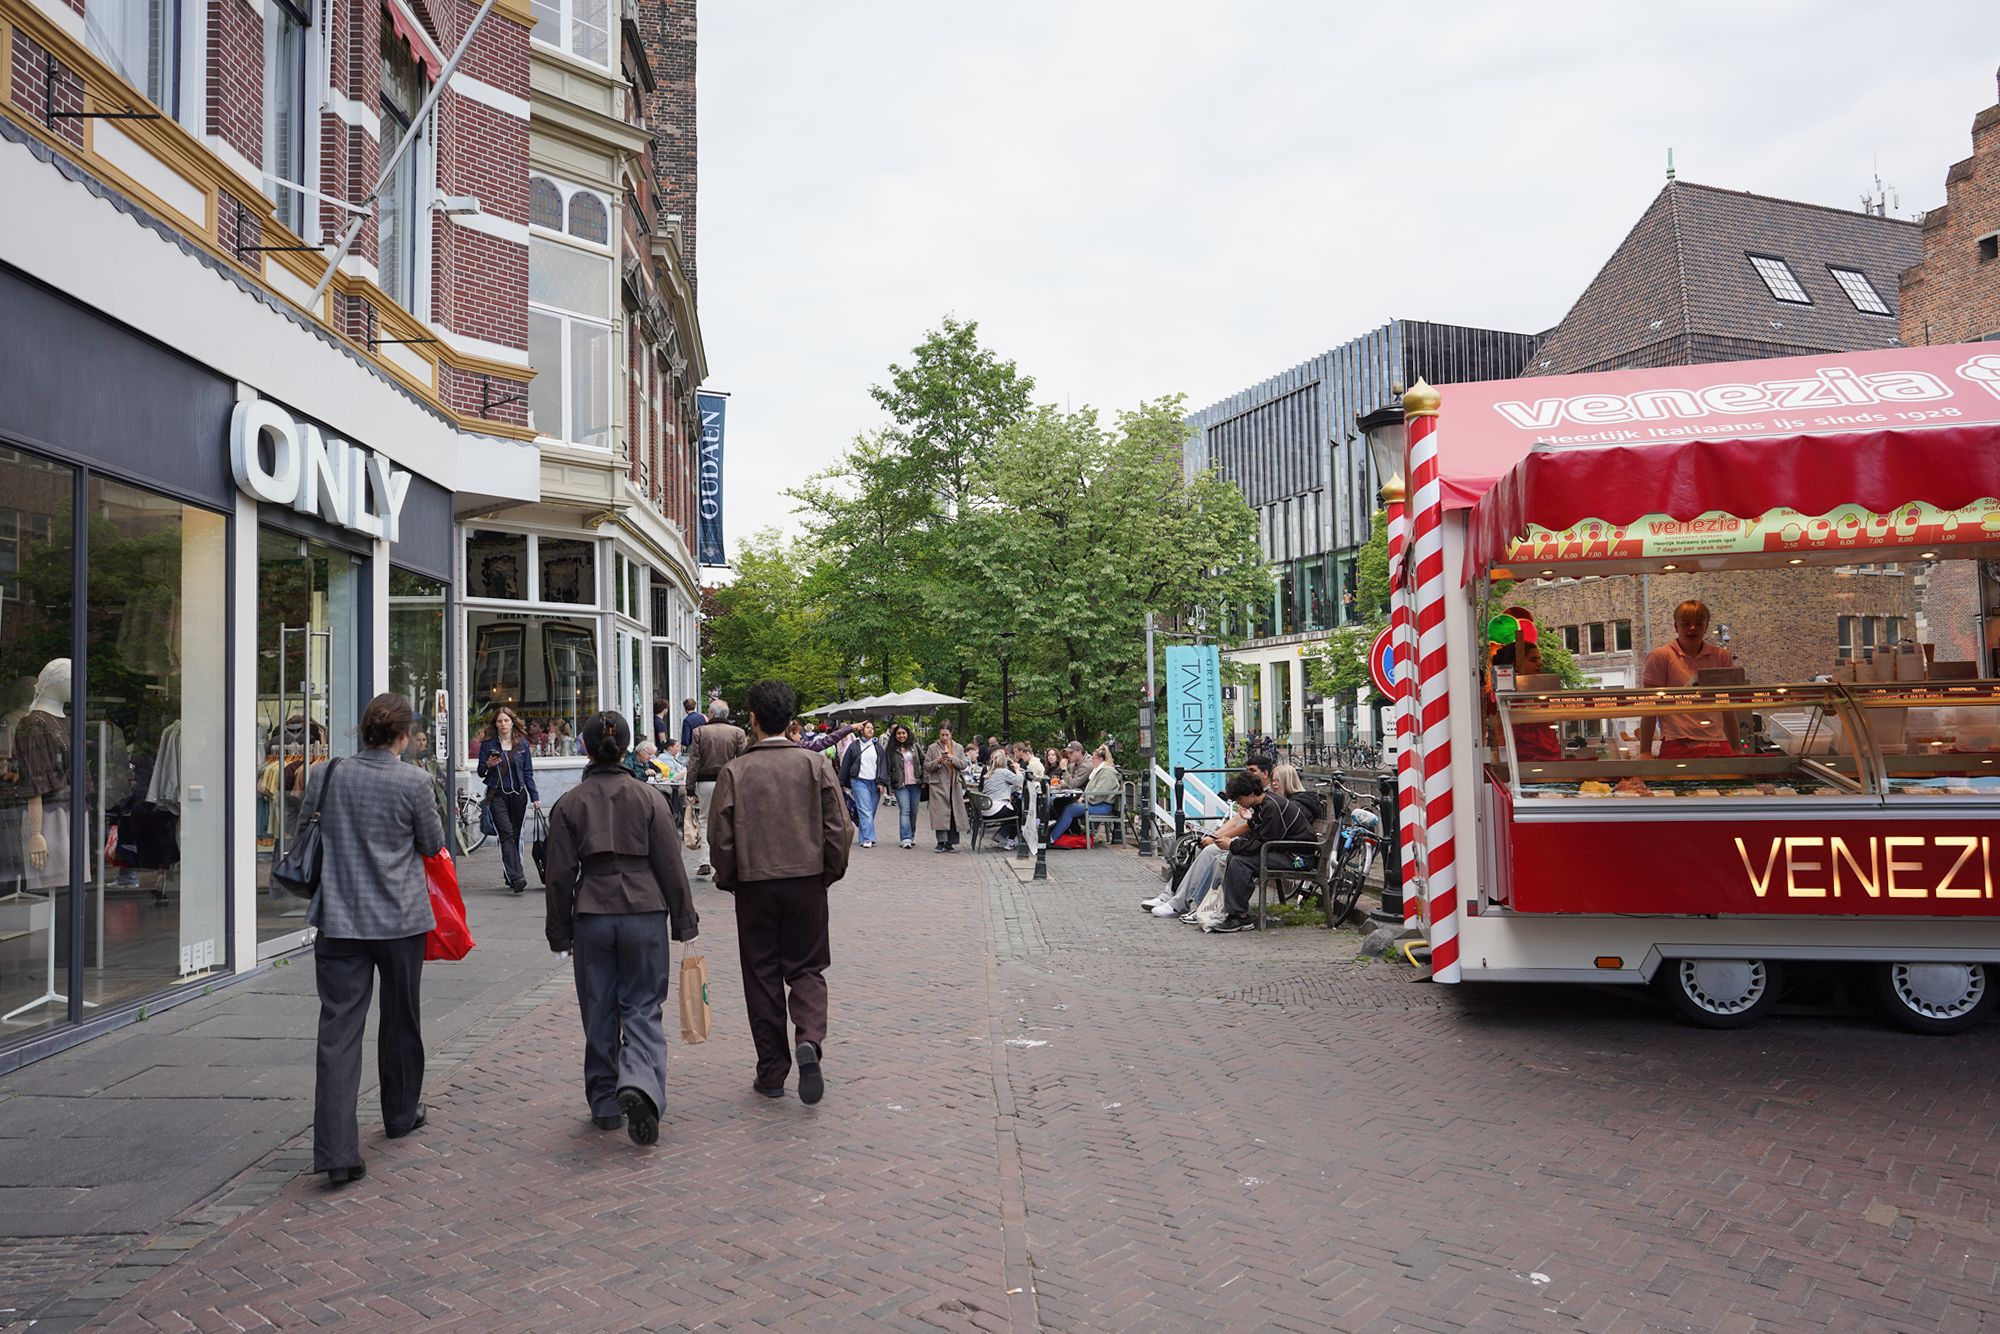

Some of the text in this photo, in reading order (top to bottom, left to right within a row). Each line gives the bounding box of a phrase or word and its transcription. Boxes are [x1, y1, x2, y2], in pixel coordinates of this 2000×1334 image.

[1494, 366, 1954, 429] venezia
[1537, 407, 1963, 444] Heerlijk Italiaans ijs sinds 1928
[230, 400, 412, 543] ONLY
[701, 410, 720, 520] OUDAEN
[1649, 513, 1740, 536] venezia
[1181, 658, 1204, 770] TAVERNA
[1206, 658, 1217, 793] GRIEKS RESTAURA
[1734, 836, 1993, 899] VENEZI
